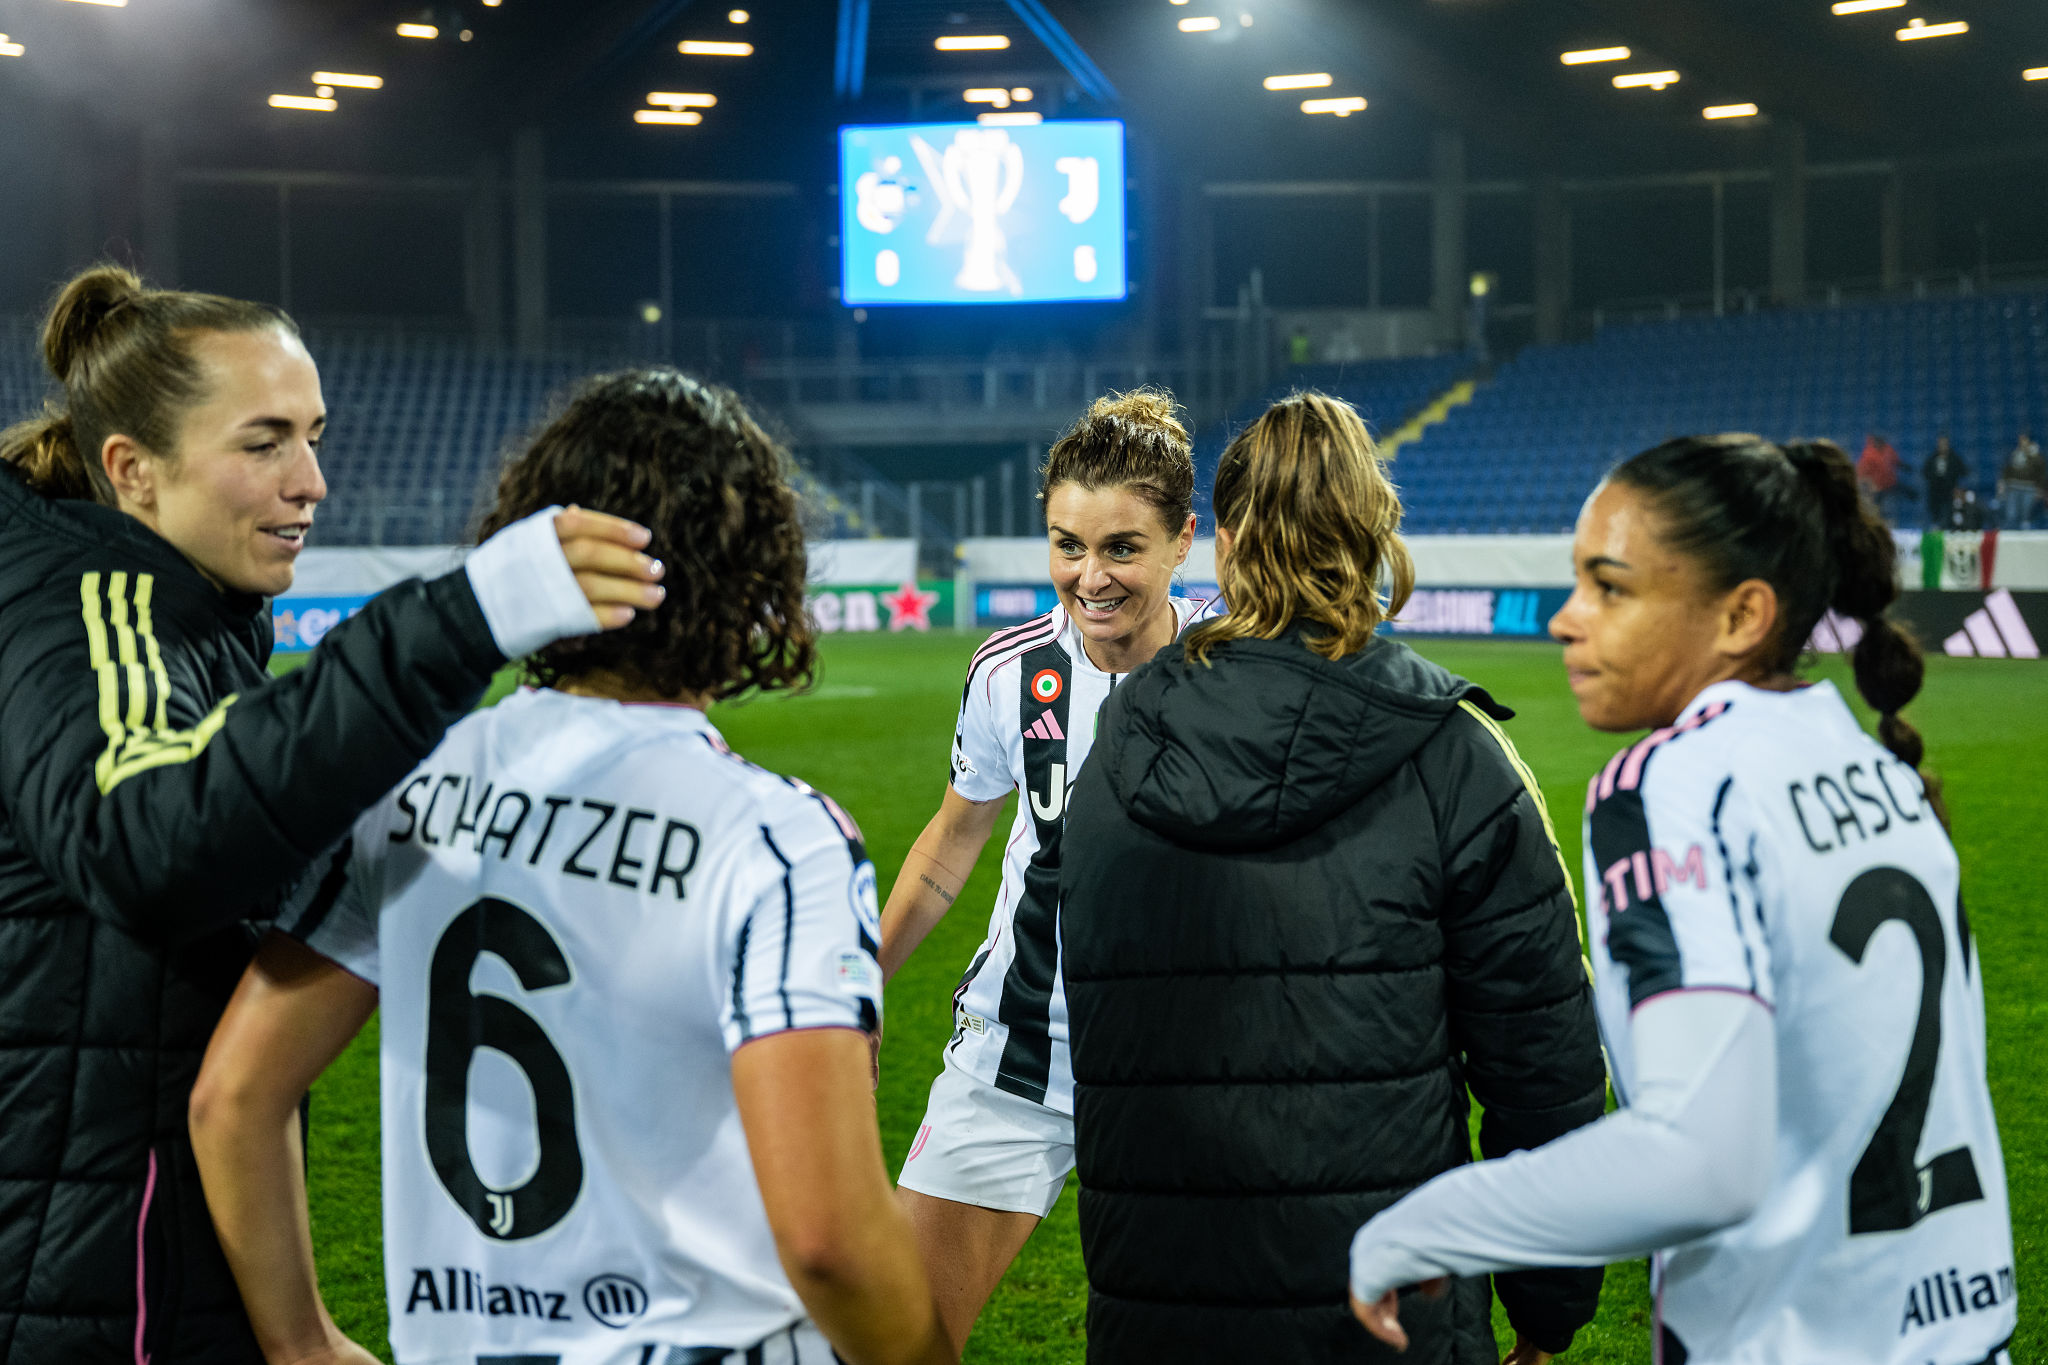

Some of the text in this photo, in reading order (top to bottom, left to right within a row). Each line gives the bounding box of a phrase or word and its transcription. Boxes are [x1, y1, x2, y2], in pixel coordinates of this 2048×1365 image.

[1491, 589, 1541, 635] ALL
[388, 773, 701, 901] SCHATZER
[1789, 759, 1926, 852] CASC
[1601, 846, 1707, 912] TIM
[424, 896, 585, 1244] 6
[1830, 866, 1985, 1235] 2
[405, 1266, 572, 1322] Allianz
